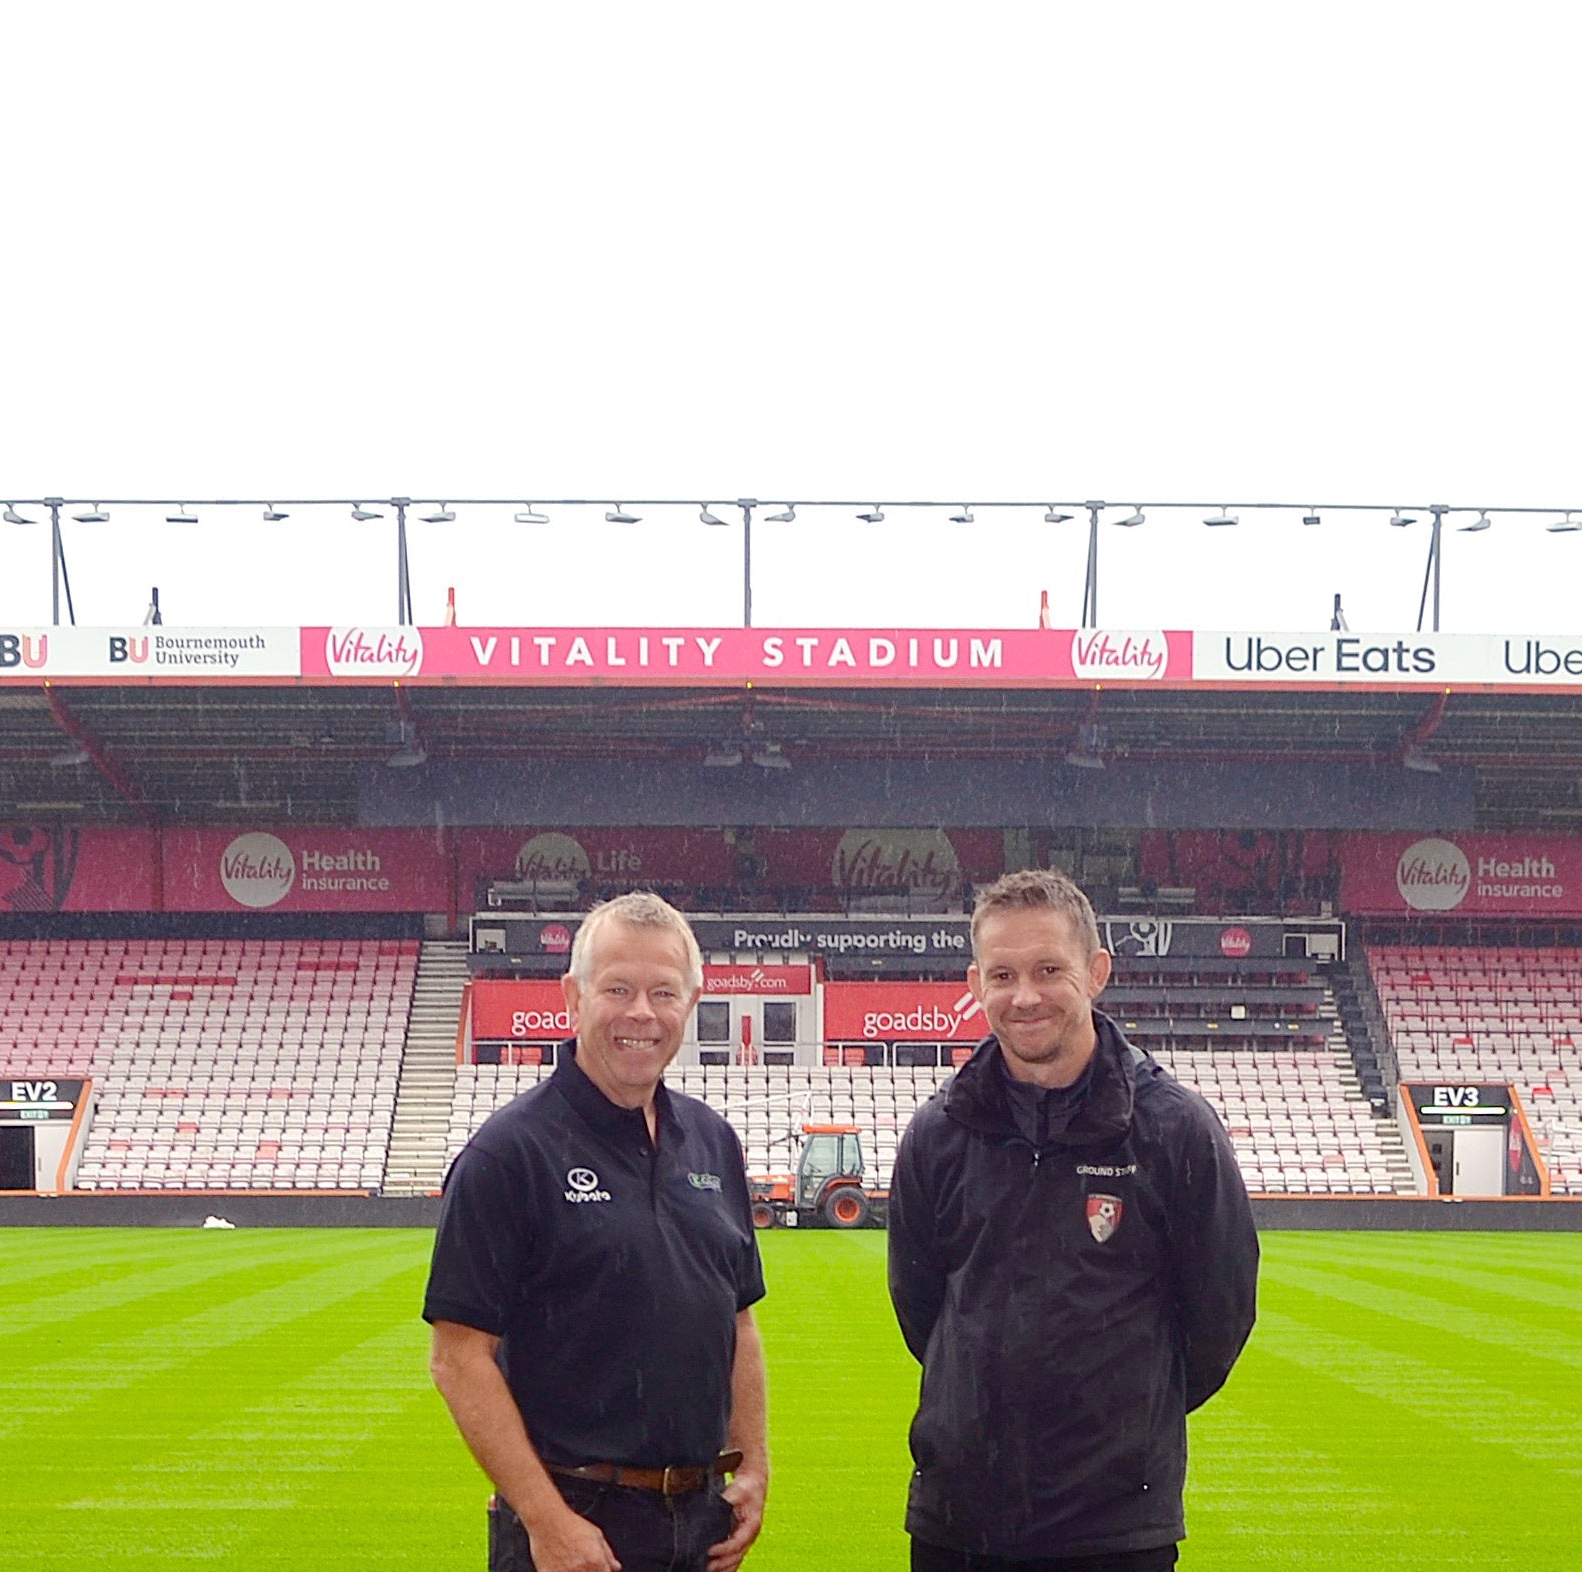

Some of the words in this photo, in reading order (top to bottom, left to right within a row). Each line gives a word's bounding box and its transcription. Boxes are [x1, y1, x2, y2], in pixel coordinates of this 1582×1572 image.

[109, 636, 149, 664] BU
[154, 635, 266, 650] Bournemouth
[331, 626, 418, 677] Vitality
[470, 636, 723, 667] VITALITY
[762, 637, 1003, 668] STADIUM
[154, 649, 240, 667] University
[1076, 629, 1164, 679] Vitality
[1224, 636, 1325, 672] Uber
[1335, 637, 1436, 674] Eats
[224, 851, 293, 888] Vitality
[301, 850, 381, 872] Health
[598, 852, 643, 871] Life
[301, 873, 390, 890] insurance
[1400, 857, 1468, 894] Vitality
[1477, 856, 1555, 878] Health
[1476, 880, 1564, 898] insurance
[817, 929, 927, 953] supporting
[931, 929, 966, 949] the
[706, 971, 788, 991] goadsby.com
[862, 1004, 962, 1038] goadsby
[11, 1081, 58, 1102] EV2
[1433, 1086, 1480, 1107] EV3
[564, 1190, 612, 1204] Kubota
